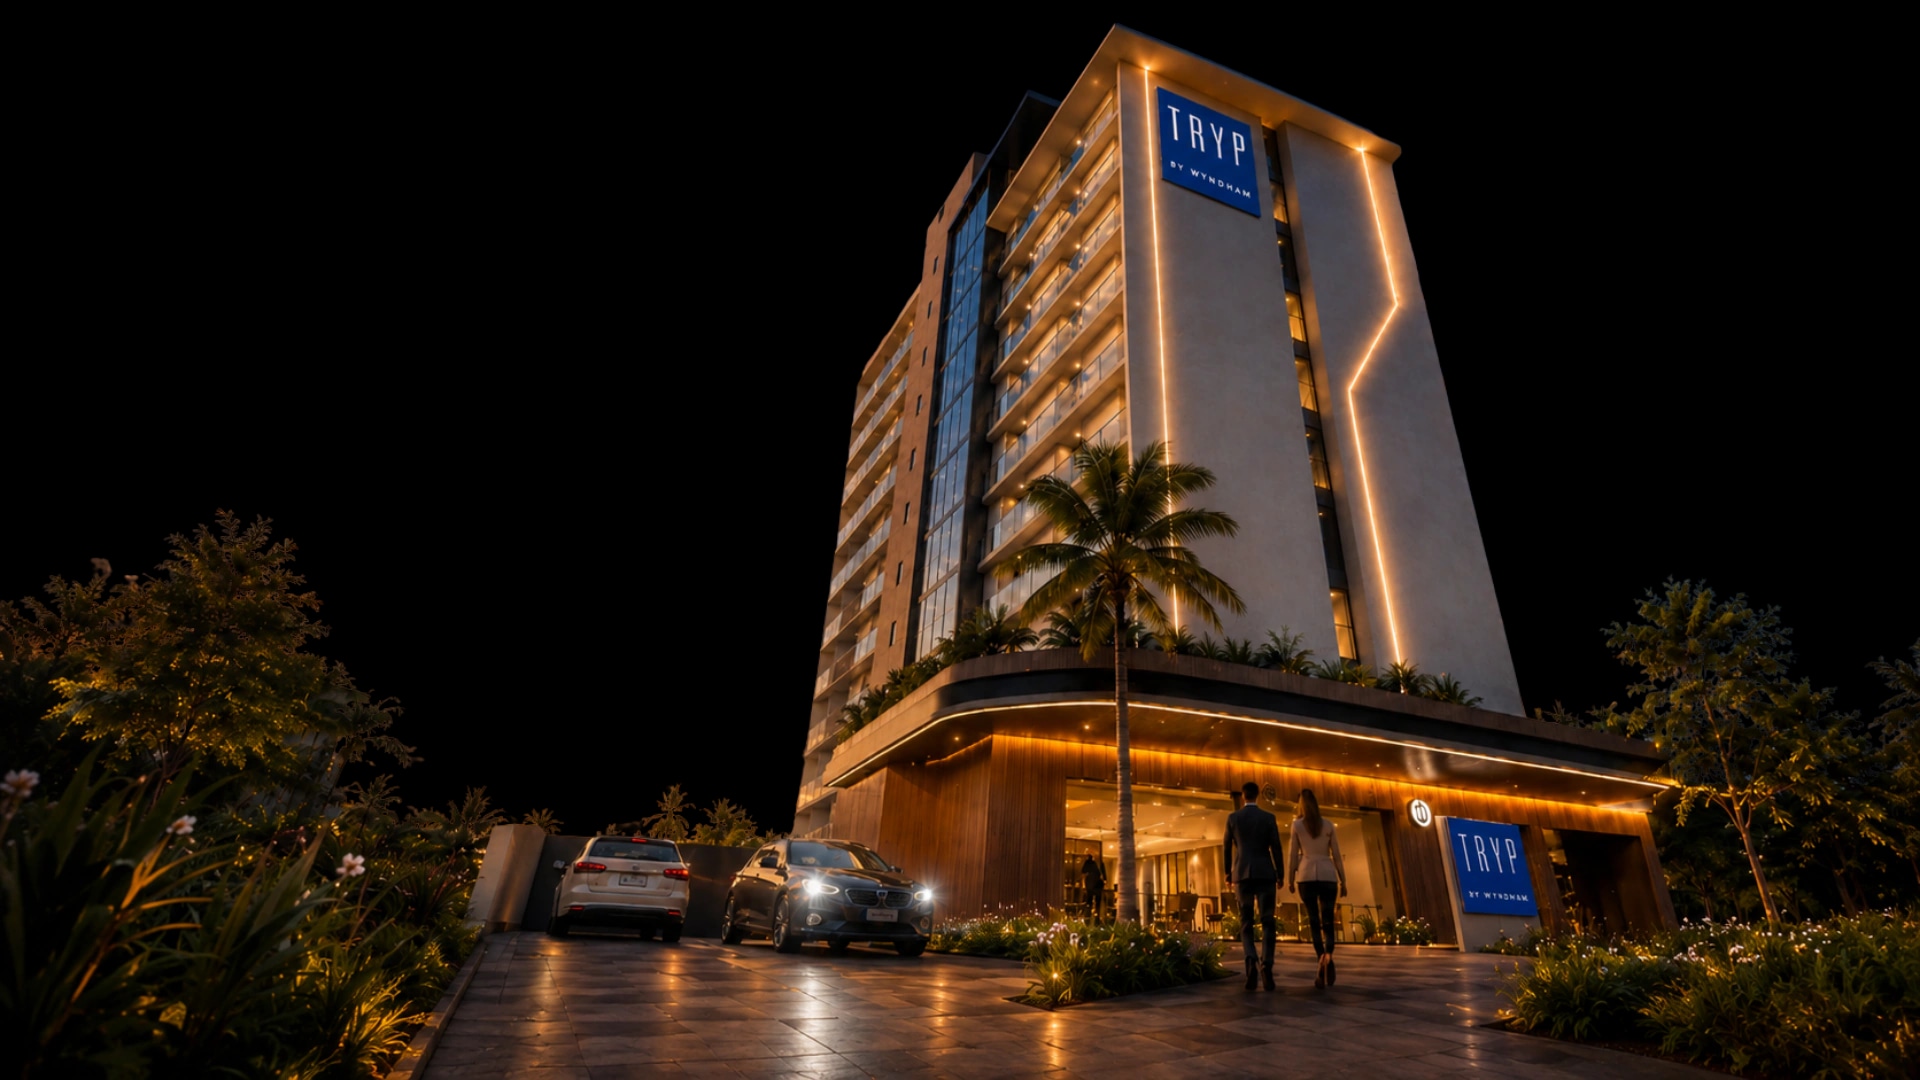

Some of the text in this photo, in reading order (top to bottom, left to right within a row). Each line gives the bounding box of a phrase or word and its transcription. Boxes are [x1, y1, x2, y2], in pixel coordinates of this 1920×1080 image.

[1167, 104, 1246, 166] TRYP
[1170, 160, 1251, 199] BY WYNDHAM
[1457, 832, 1517, 875] TRYP
